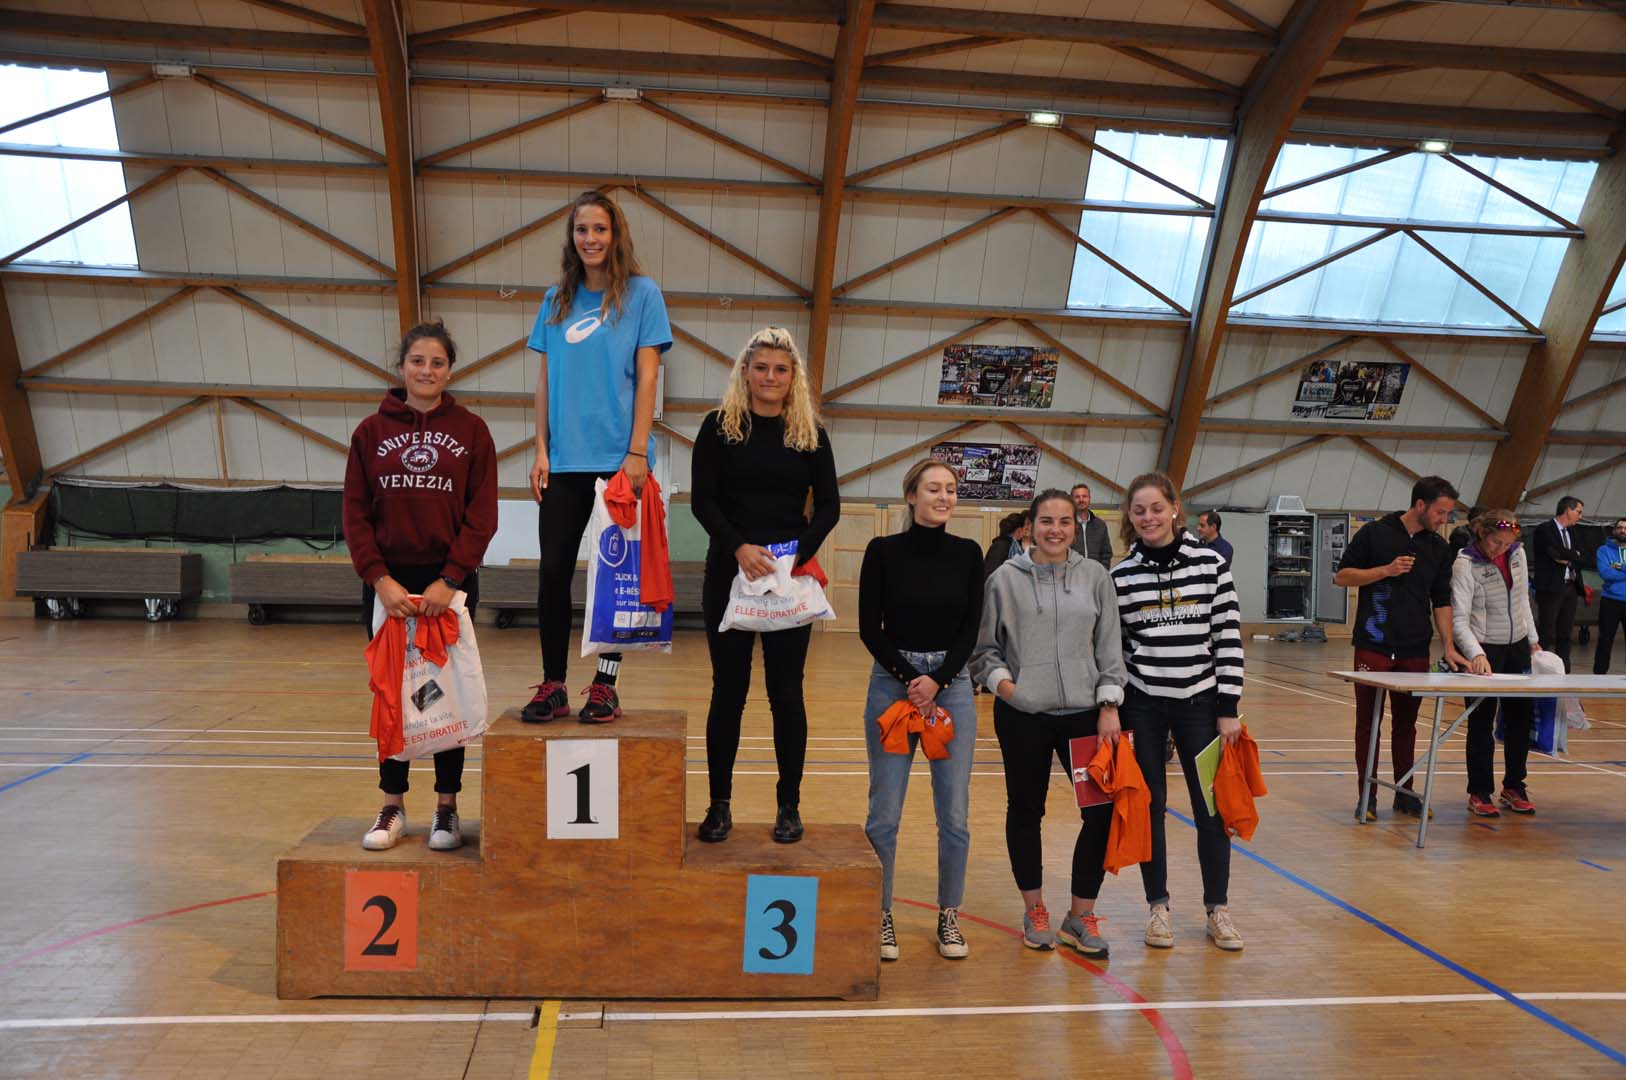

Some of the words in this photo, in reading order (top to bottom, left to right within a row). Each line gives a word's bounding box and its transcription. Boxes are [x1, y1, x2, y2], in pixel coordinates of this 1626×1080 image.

[379, 474, 453, 491] VENEZIA
[735, 605, 756, 617] ELLE
[411, 733, 426, 744] EST
[430, 720, 469, 738] GRATUITE
[566, 763, 599, 824] 1
[361, 895, 400, 956] 2
[758, 899, 798, 960] 3
